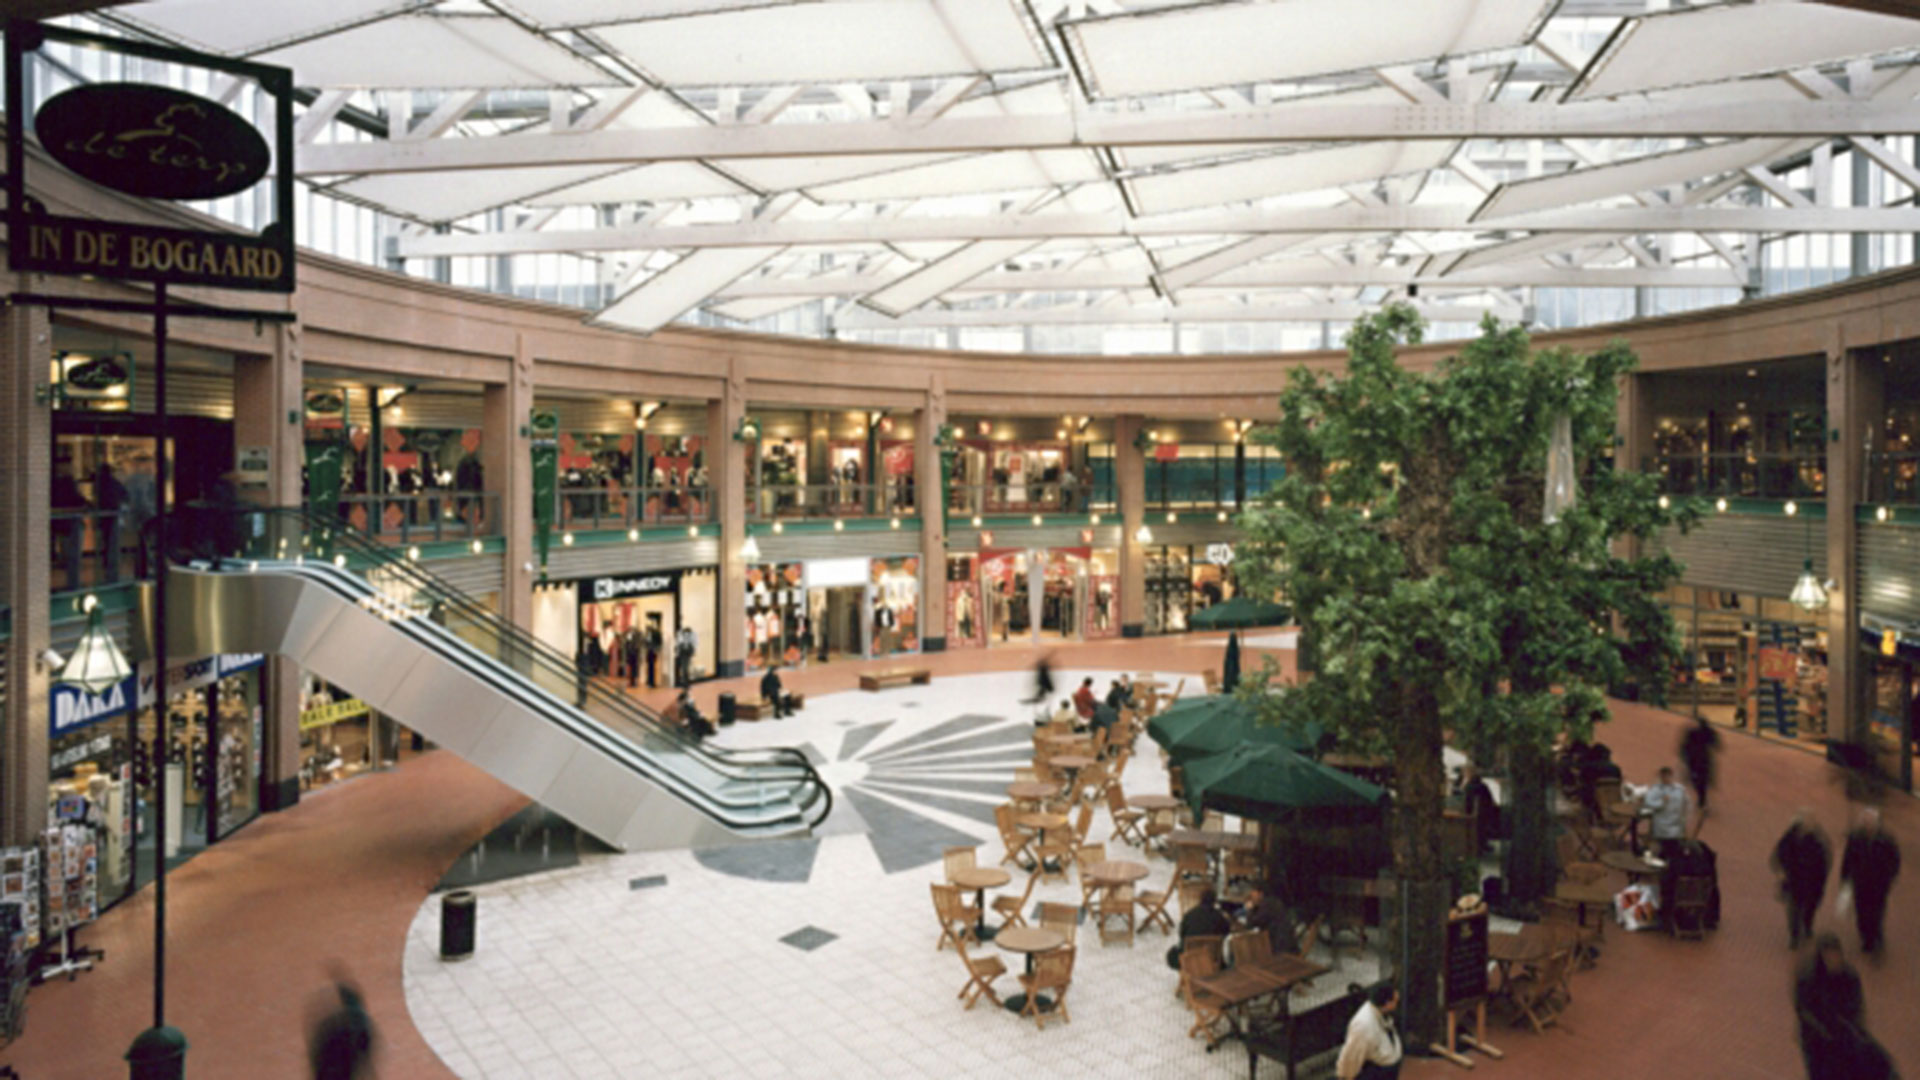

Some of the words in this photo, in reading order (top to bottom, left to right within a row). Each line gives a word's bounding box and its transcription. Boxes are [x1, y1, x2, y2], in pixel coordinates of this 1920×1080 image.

[29, 225, 62, 261] IN
[73, 230, 118, 266] DE
[130, 235, 283, 280] BOGAARD
